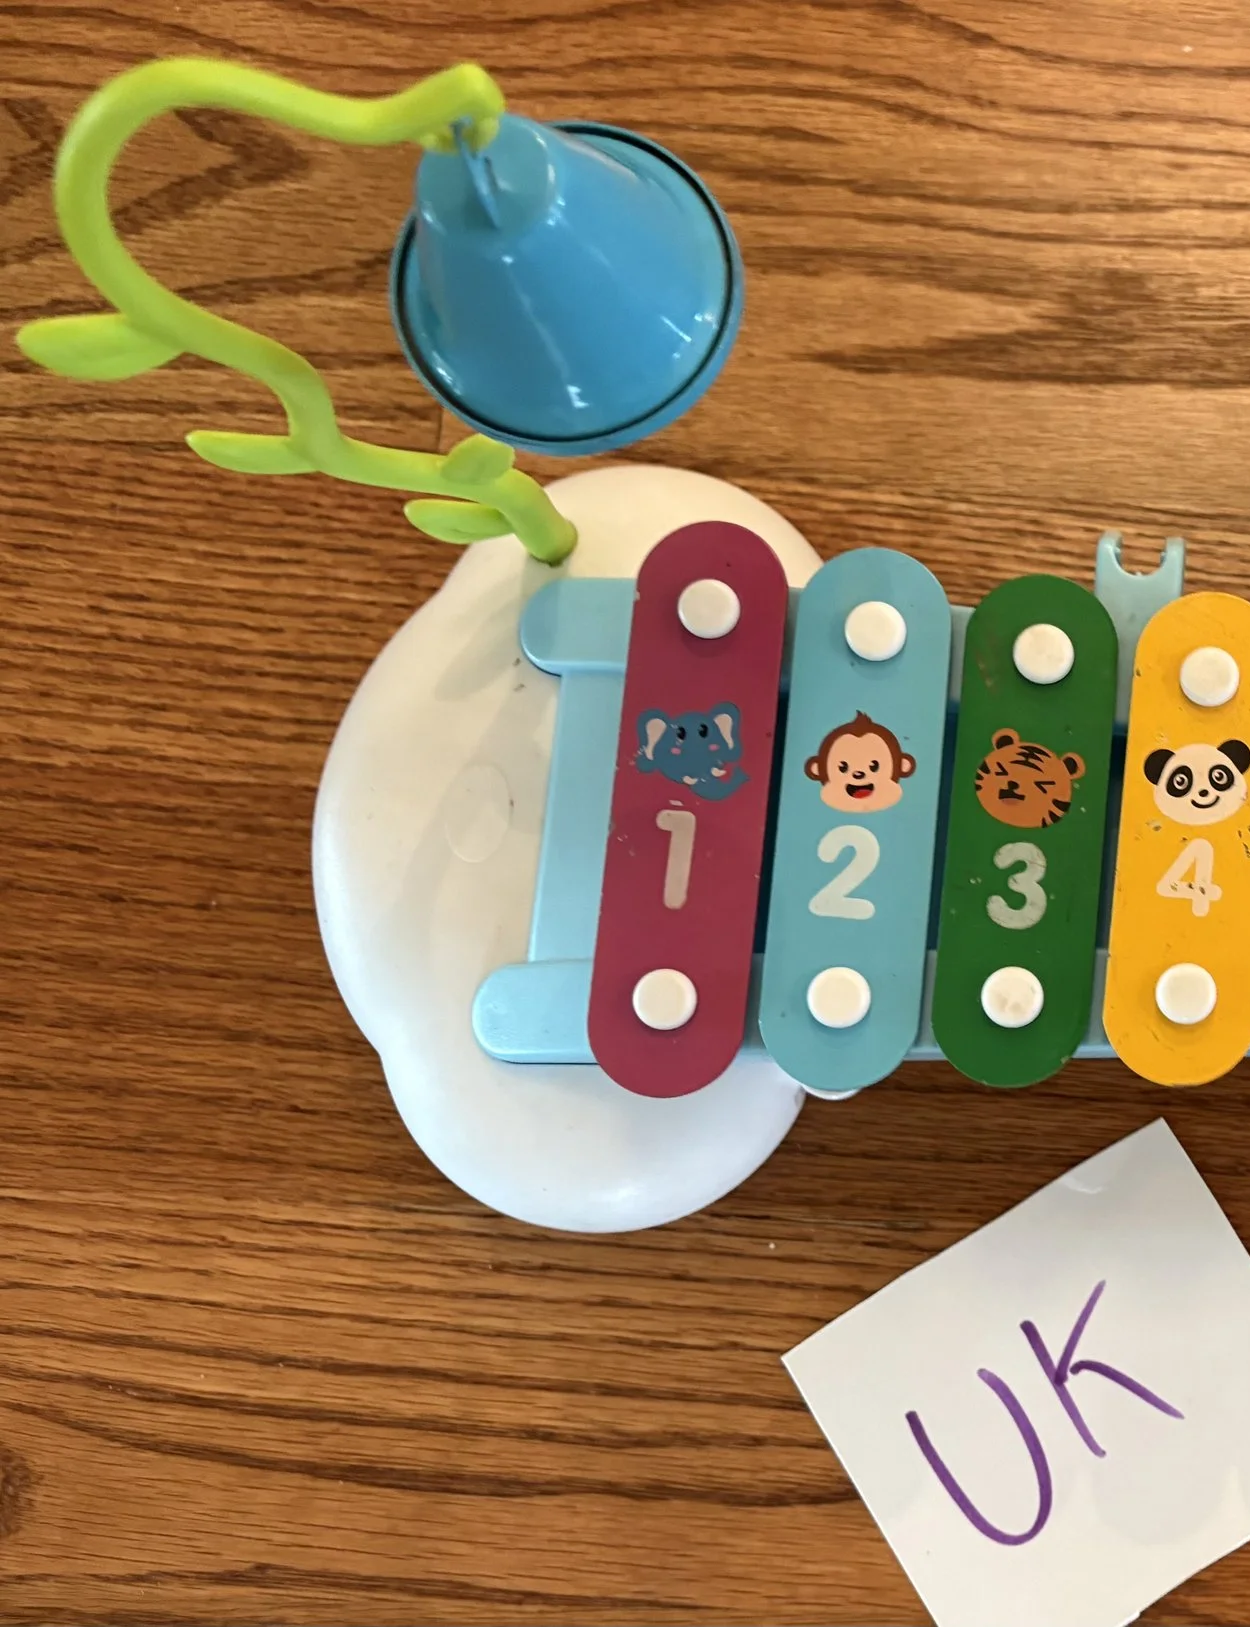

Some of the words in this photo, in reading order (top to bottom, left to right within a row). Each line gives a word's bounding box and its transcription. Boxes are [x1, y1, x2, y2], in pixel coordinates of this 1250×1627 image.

[656, 809, 696, 910] 1
[808, 825, 880, 920] 2
[986, 841, 1048, 930] 3
[1156, 838, 1222, 917] 4
[904, 1279, 1186, 1546] UK
